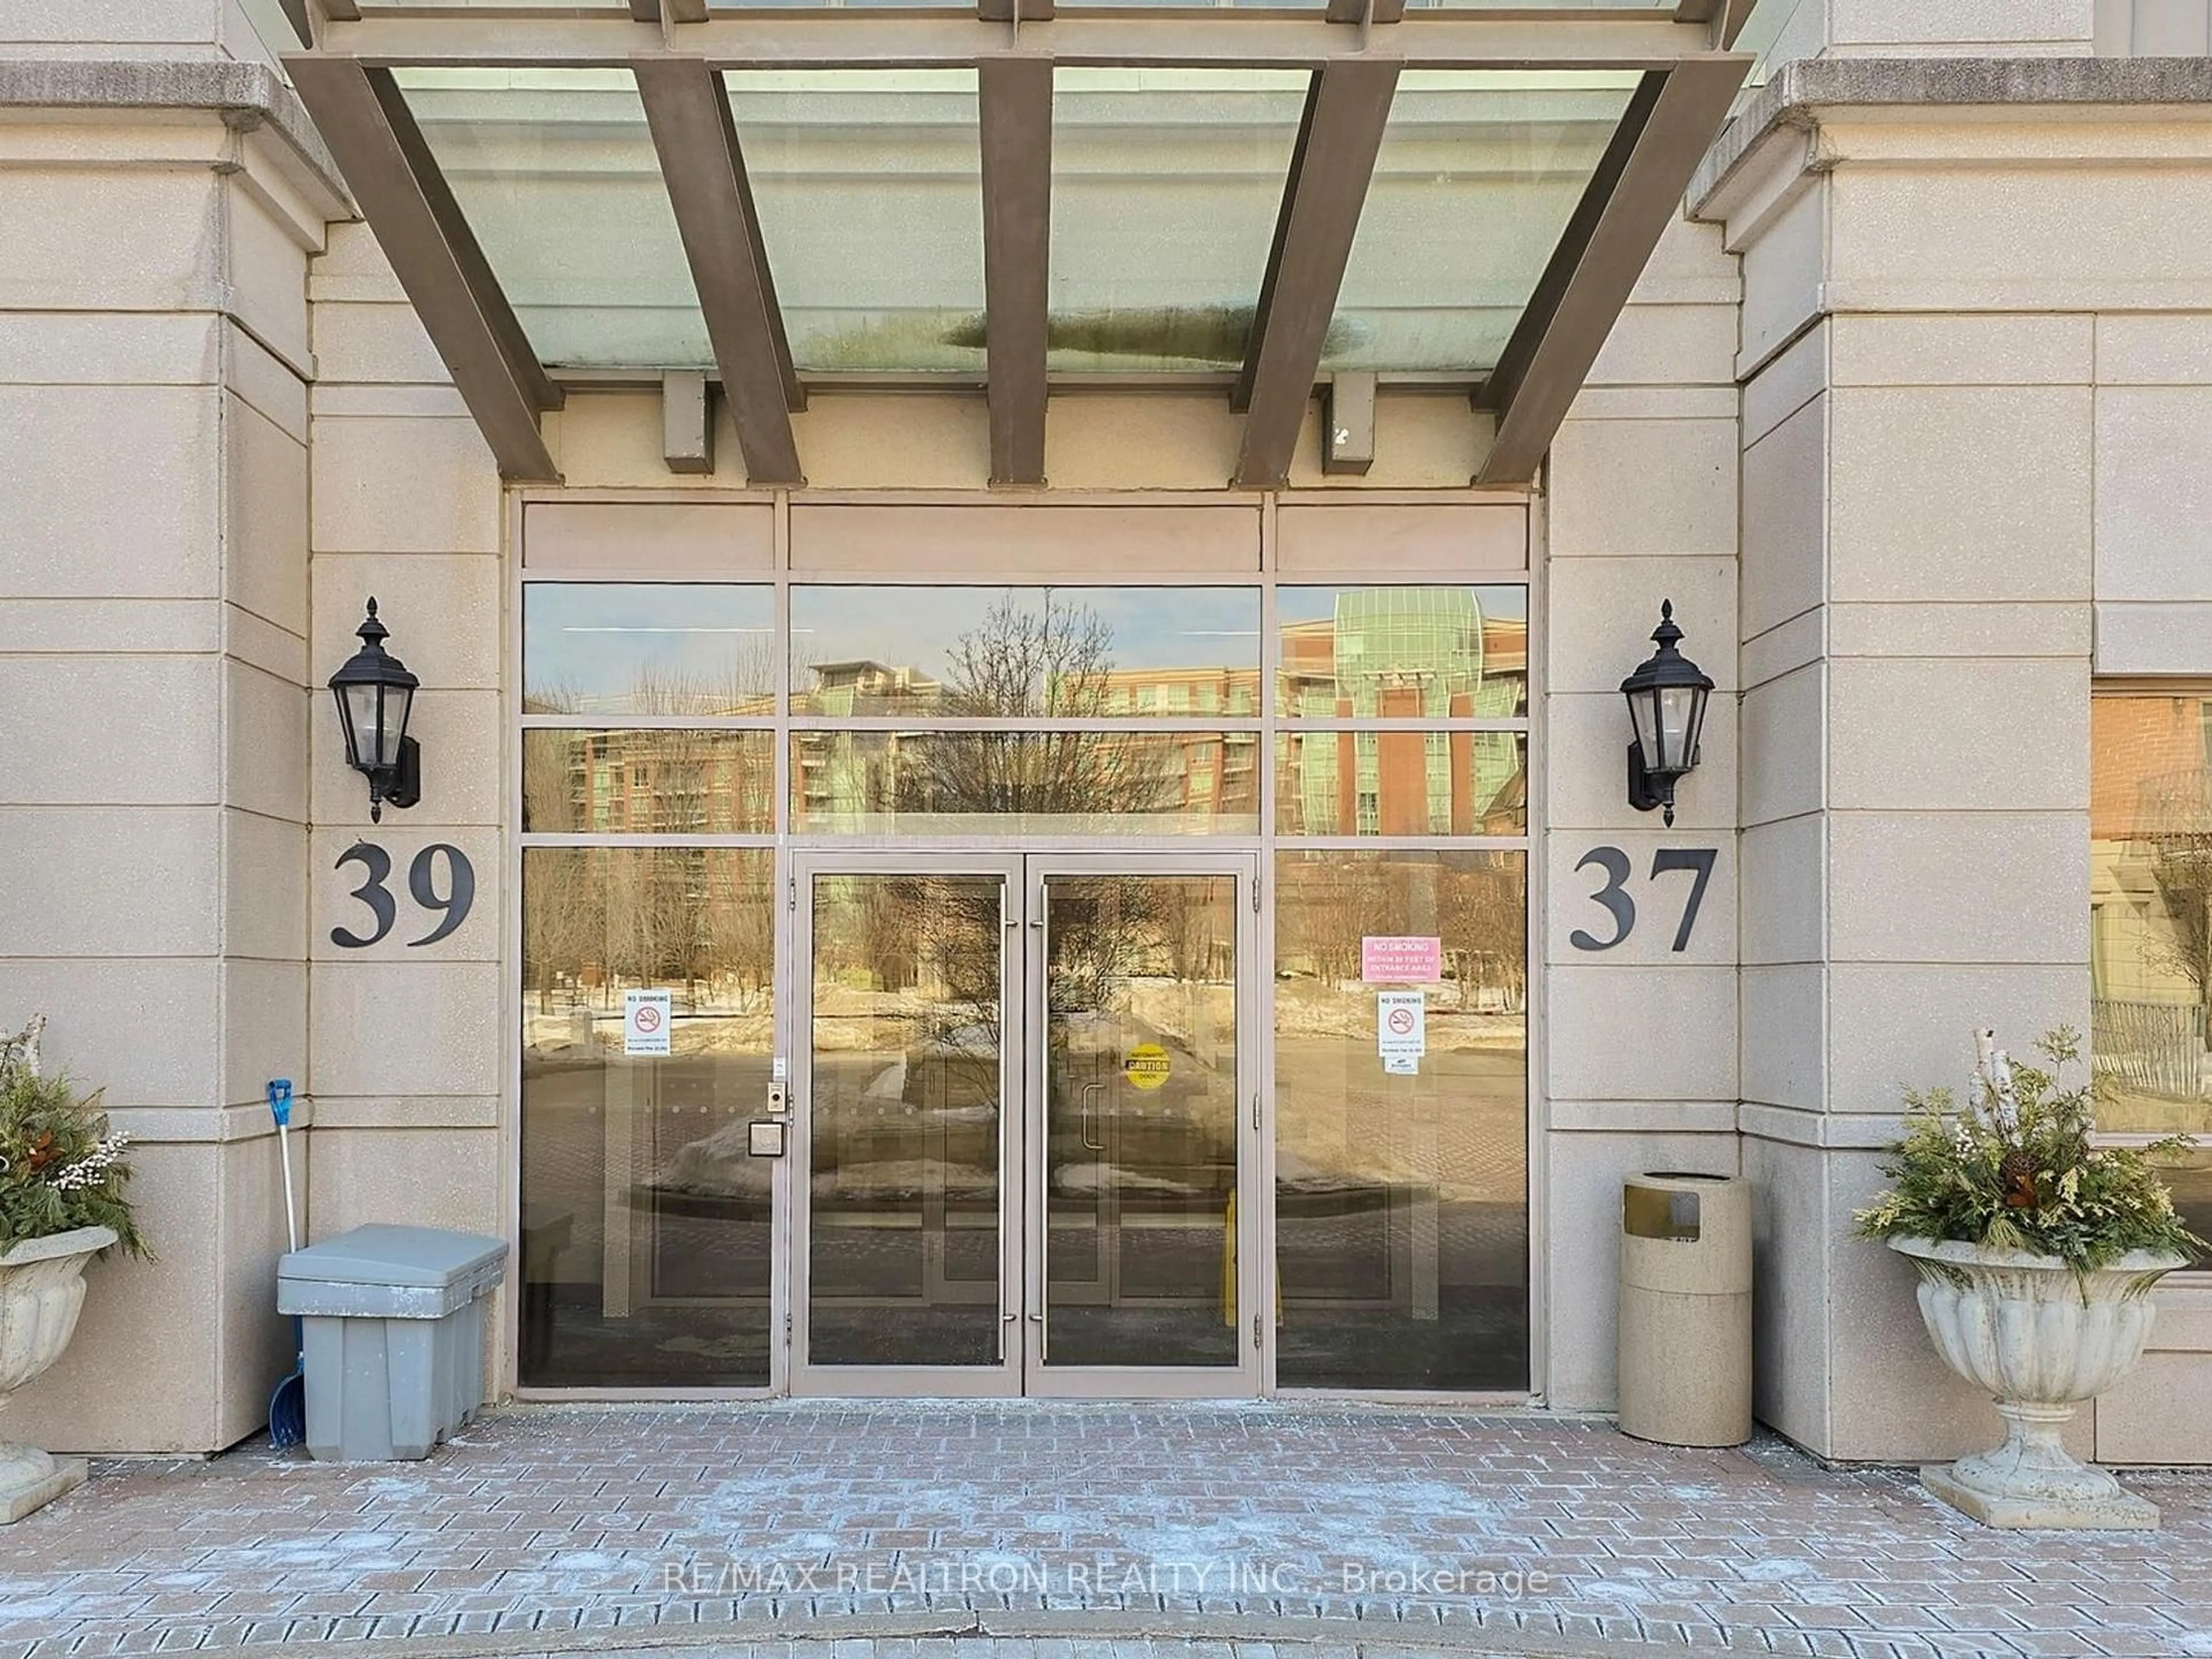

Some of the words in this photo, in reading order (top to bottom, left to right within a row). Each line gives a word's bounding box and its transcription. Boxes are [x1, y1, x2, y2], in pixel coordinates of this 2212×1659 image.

[331, 843, 475, 948] 39
[1570, 846, 1718, 951] 37
[1373, 942, 1387, 952] NO
[1388, 942, 1429, 952] SMOKING
[1128, 1060, 1168, 1070] CAUTION
